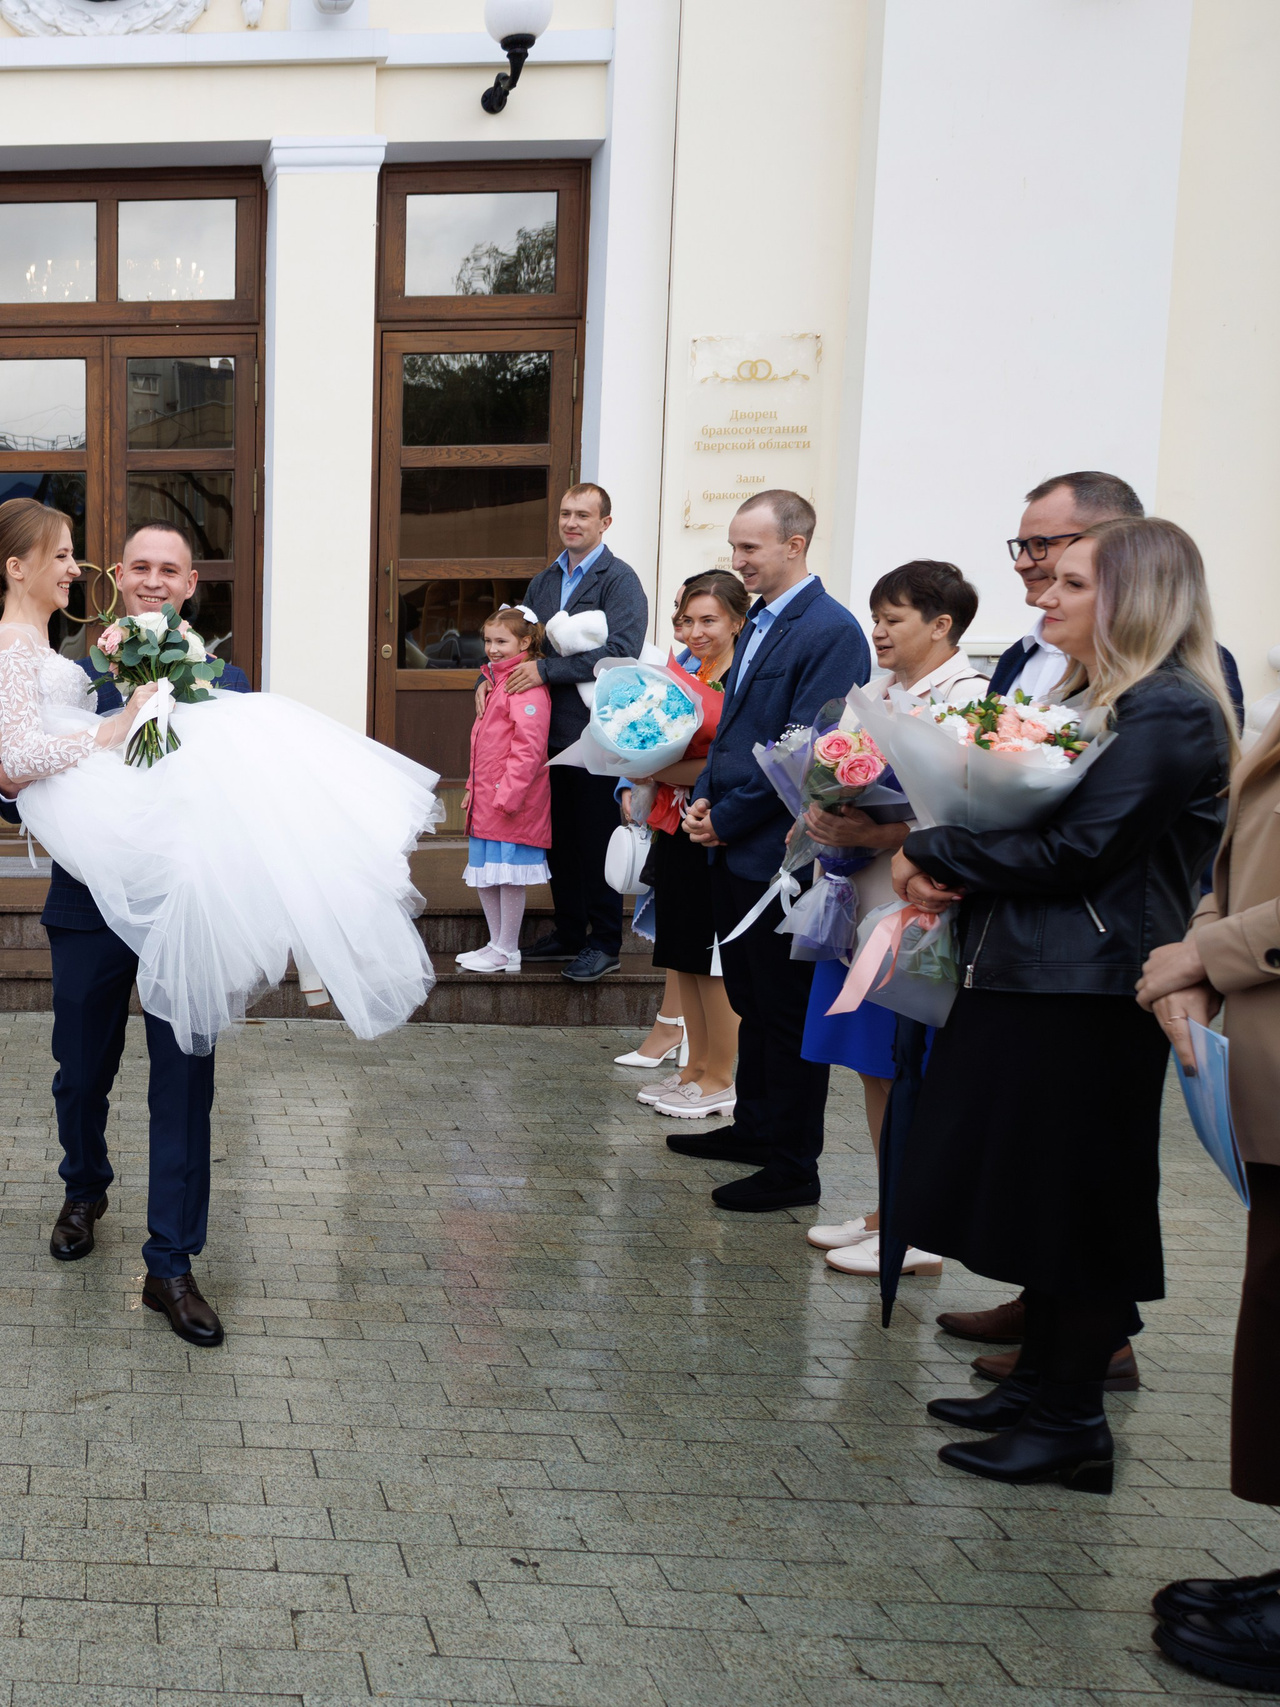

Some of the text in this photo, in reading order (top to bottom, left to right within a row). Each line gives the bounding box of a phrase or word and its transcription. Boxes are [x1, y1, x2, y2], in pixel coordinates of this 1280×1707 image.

[730, 410, 778, 421] Дворец
[702, 425, 808, 438] бракосочетания
[694, 438, 810, 453] Тверской области
[736, 474, 765, 483] Залы
[702, 490, 760, 502] бракосоч
